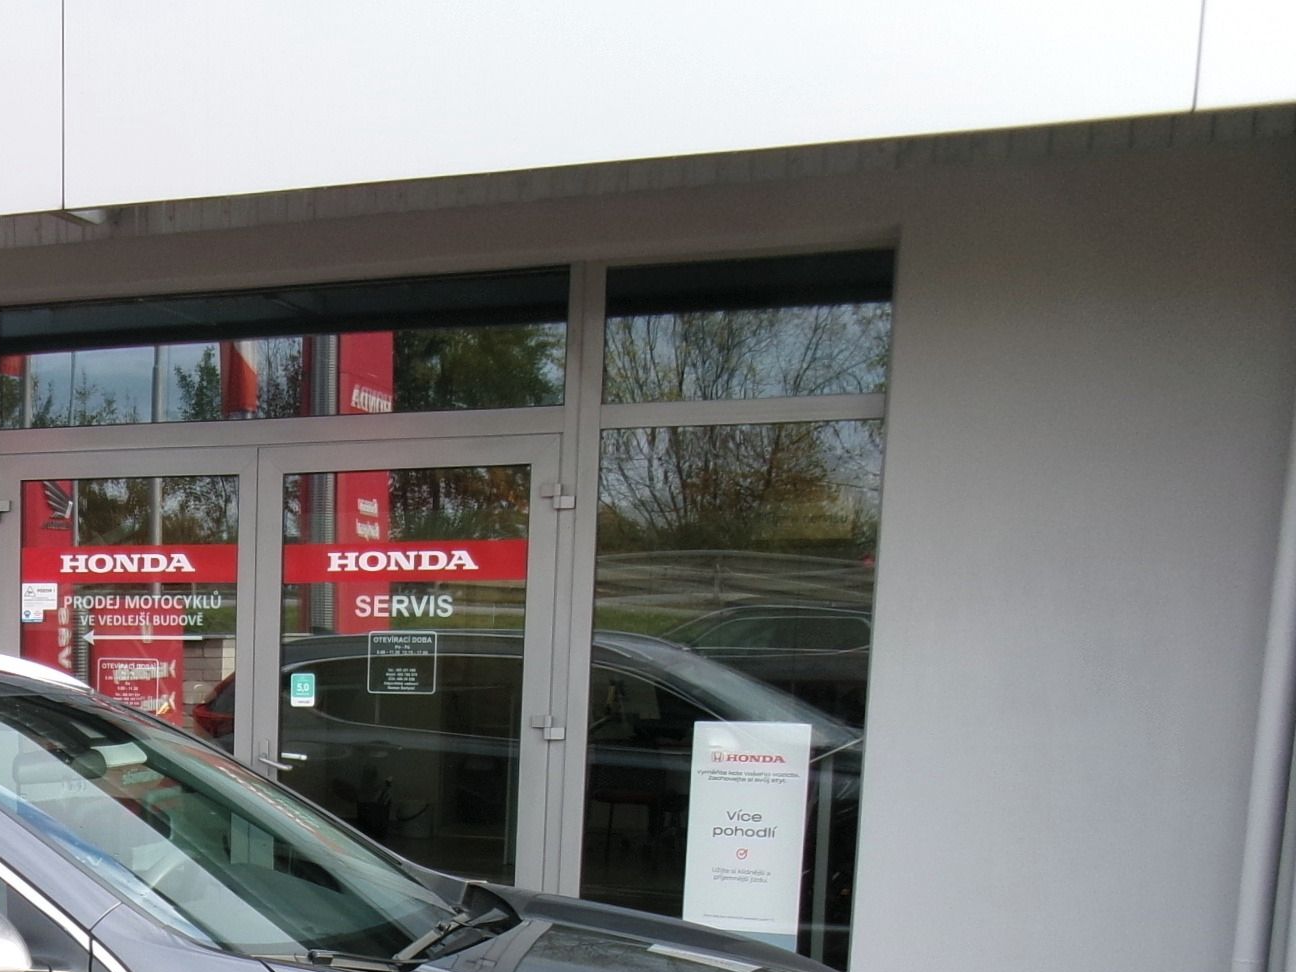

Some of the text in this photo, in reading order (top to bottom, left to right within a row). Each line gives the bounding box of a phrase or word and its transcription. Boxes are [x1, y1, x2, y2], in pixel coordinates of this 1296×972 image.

[60, 553, 196, 573] HONDA
[327, 550, 479, 572] HONDA
[63, 595, 120, 610] PRODEJ
[125, 589, 222, 610] MOTOCYKLŮ
[354, 595, 454, 618] SERVIS
[80, 612, 203, 626] VE VEDLEJŠÍ BUDOVĚ
[726, 754, 786, 764] HONDA
[726, 809, 763, 823] Více
[712, 825, 778, 839] pohodlí
